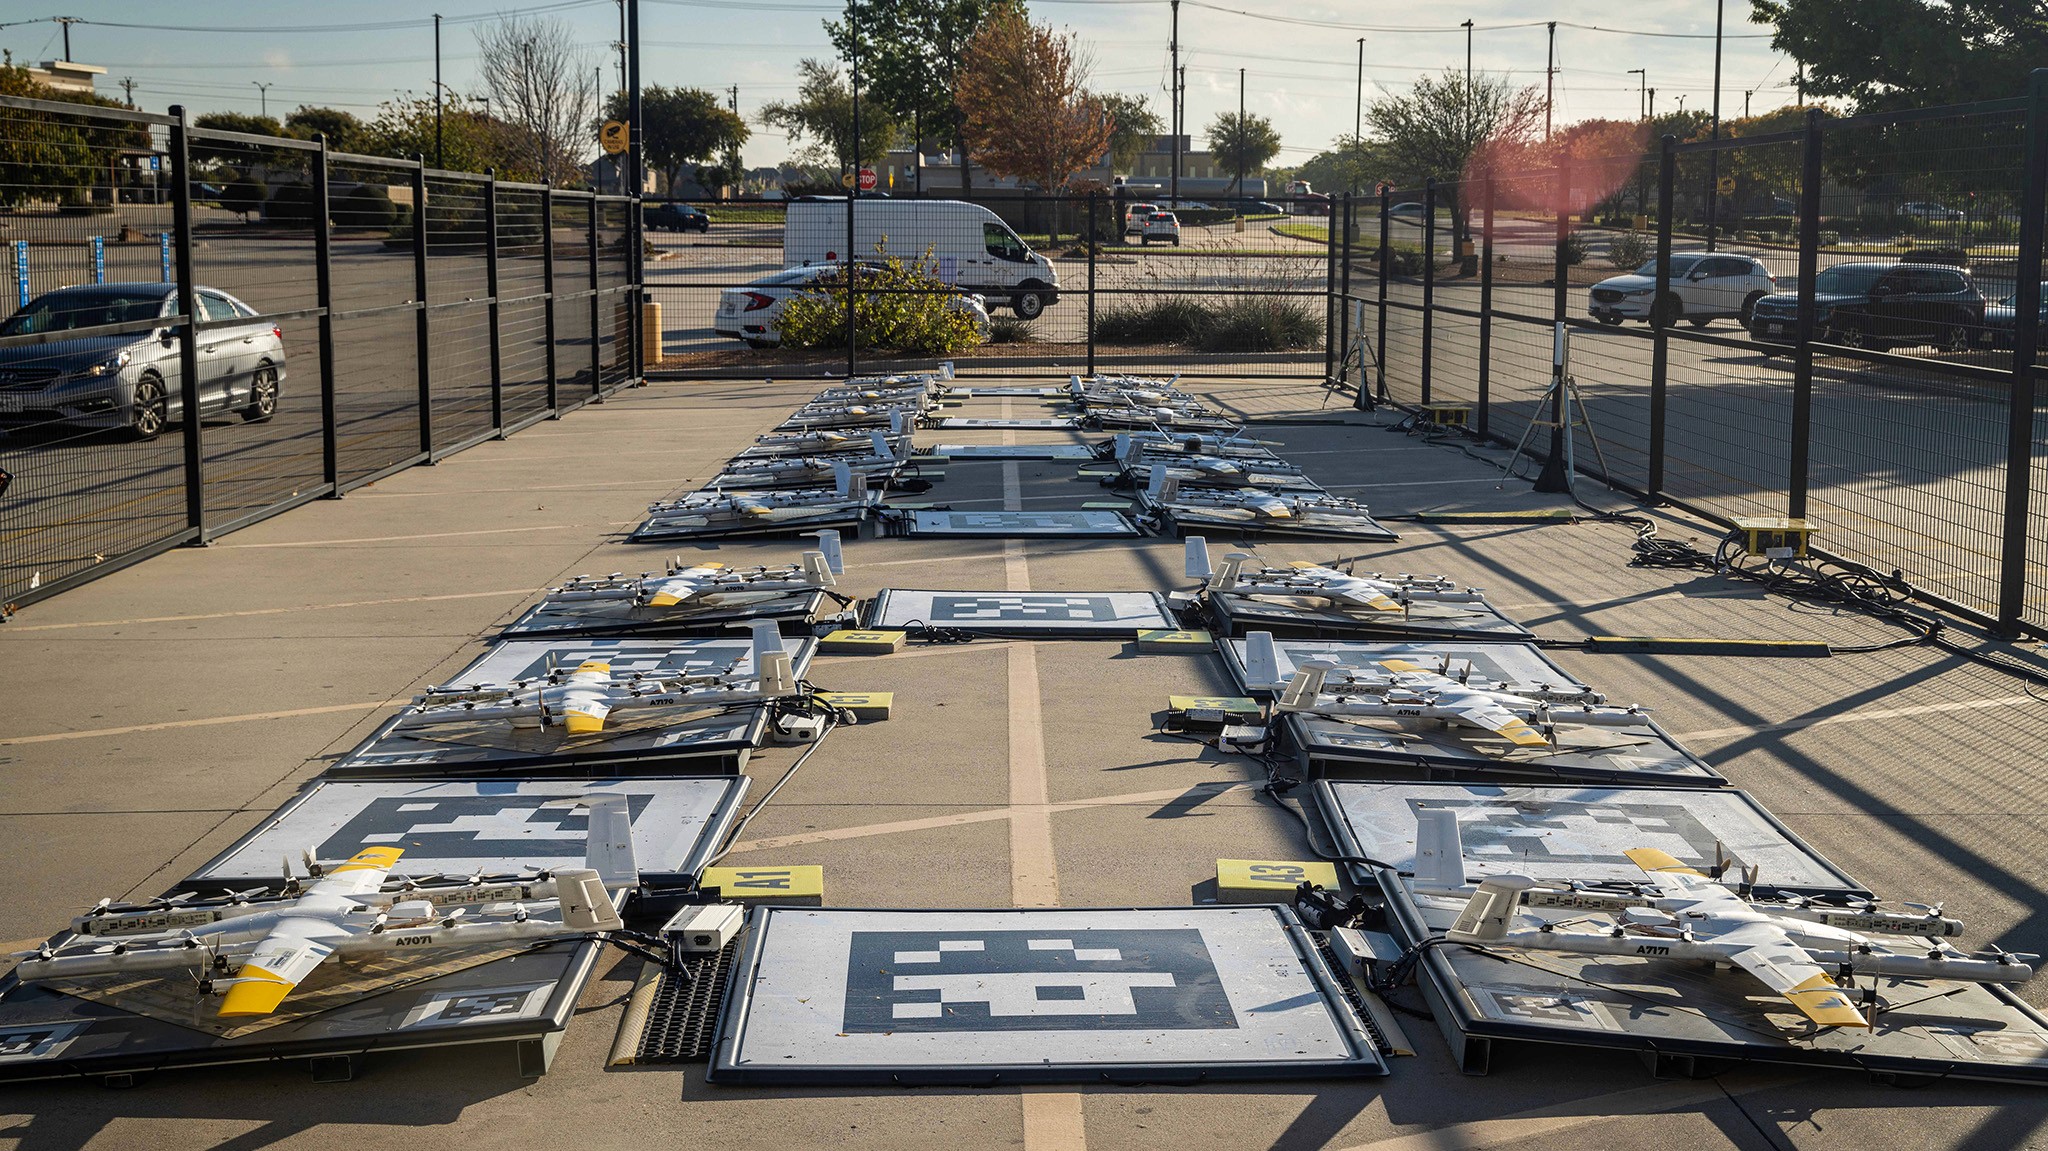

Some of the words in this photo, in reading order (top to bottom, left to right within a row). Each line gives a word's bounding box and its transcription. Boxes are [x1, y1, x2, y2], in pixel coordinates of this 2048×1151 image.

[649, 698, 674, 706] A7170
[829, 695, 870, 704] C1
[1249, 864, 1305, 884] A3
[734, 871, 791, 889] A1
[395, 935, 432, 946] A7071
[1636, 945, 1670, 955] A7171
